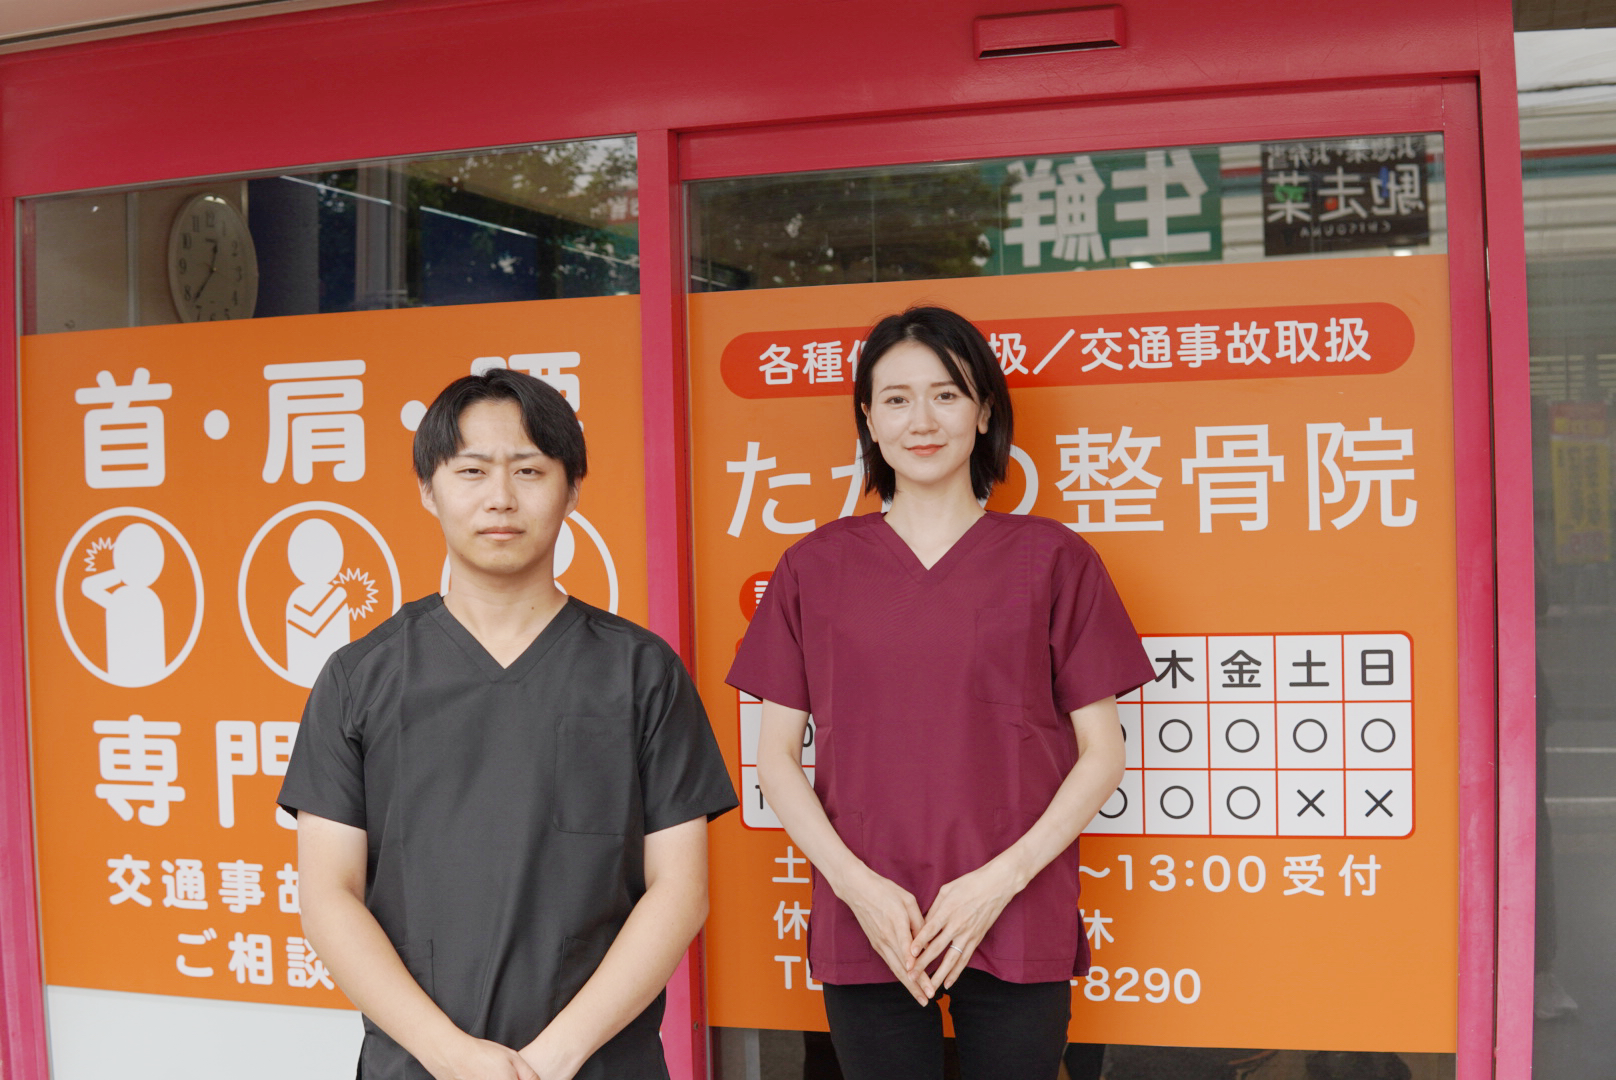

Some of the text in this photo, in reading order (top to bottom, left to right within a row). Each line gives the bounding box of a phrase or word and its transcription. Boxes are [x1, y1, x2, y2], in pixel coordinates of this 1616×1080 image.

[1154, 649, 1394, 689] 木 金 土 日
[176, 927, 335, 990] ご相談
